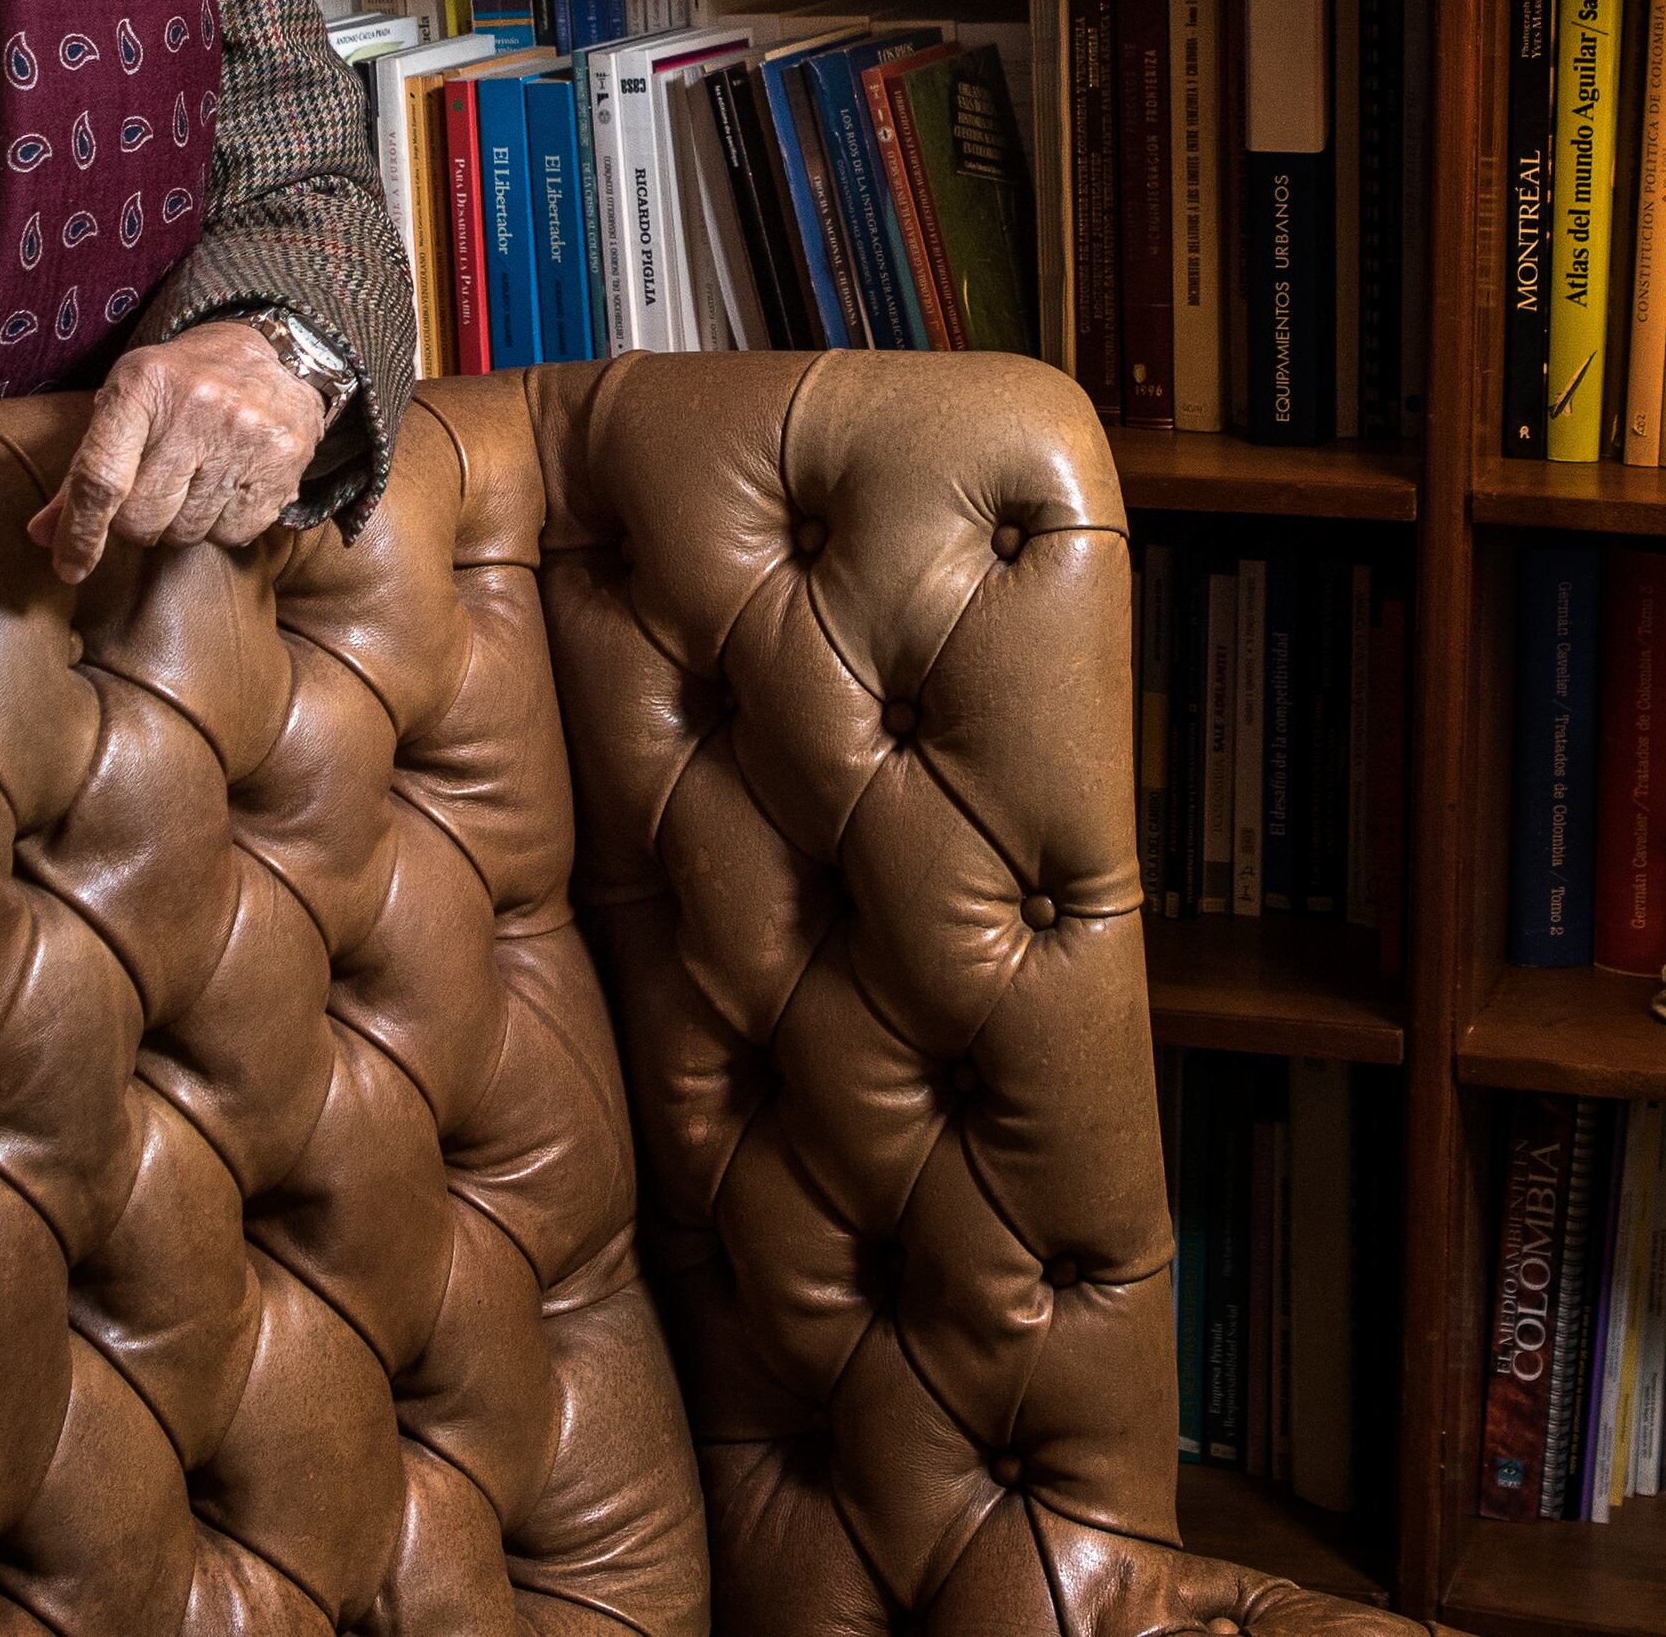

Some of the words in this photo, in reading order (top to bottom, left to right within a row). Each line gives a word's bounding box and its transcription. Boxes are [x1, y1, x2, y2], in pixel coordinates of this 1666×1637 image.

[1531, 32, 1542, 59] YVES
[620, 77, 647, 95] casa
[715, 85, 724, 95] les
[723, 125, 732, 133] du
[839, 108, 852, 131] LOS
[492, 146, 509, 164] El
[543, 155, 560, 172] El
[844, 132, 858, 158] RIOS
[849, 160, 861, 175] DE
[1573, 125, 1593, 203] mundo
[634, 168, 651, 245] RICARDO
[855, 177, 865, 192] LA
[494, 168, 512, 255] Libertador
[545, 177, 565, 263] Libertador
[858, 194, 886, 270] INTEGRACION
[1274, 174, 1290, 269] URBANOS
[1514, 149, 1541, 312] MONTRÉAL
[1566, 209, 1591, 242] del
[812, 175, 827, 214] TROCHA
[822, 218, 841, 267] NACIONAL
[836, 270, 857, 326] CIUDADANA
[640, 249, 656, 306] PIGLIA
[1565, 248, 1590, 307] Atlas
[1275, 281, 1291, 422] EQUIPAMIENTOS
[1555, 581, 1573, 634] Germán
[1271, 632, 1291, 733] competitividad
[1556, 642, 1571, 696] Cavelier
[1271, 734, 1288, 748] la
[1271, 751, 1287, 768] de
[1554, 715, 1570, 776] Tratados
[1270, 770, 1289, 819] desafío
[1553, 783, 1566, 798] de
[1271, 821, 1287, 836] El
[1552, 804, 1568, 866] Colombia
[1550, 886, 1565, 922] Tomo
[1549, 927, 1563, 935] 2
[1512, 1138, 1530, 1166] EN
[1504, 1169, 1527, 1273] AMBIENTE
[1510, 1141, 1561, 1381] COLOMBIA
[1499, 1278, 1519, 1345] MEDIO
[1210, 1323, 1223, 1363] Privada
[1497, 1350, 1513, 1374] EL
[1208, 1366, 1224, 1414] Empresa
